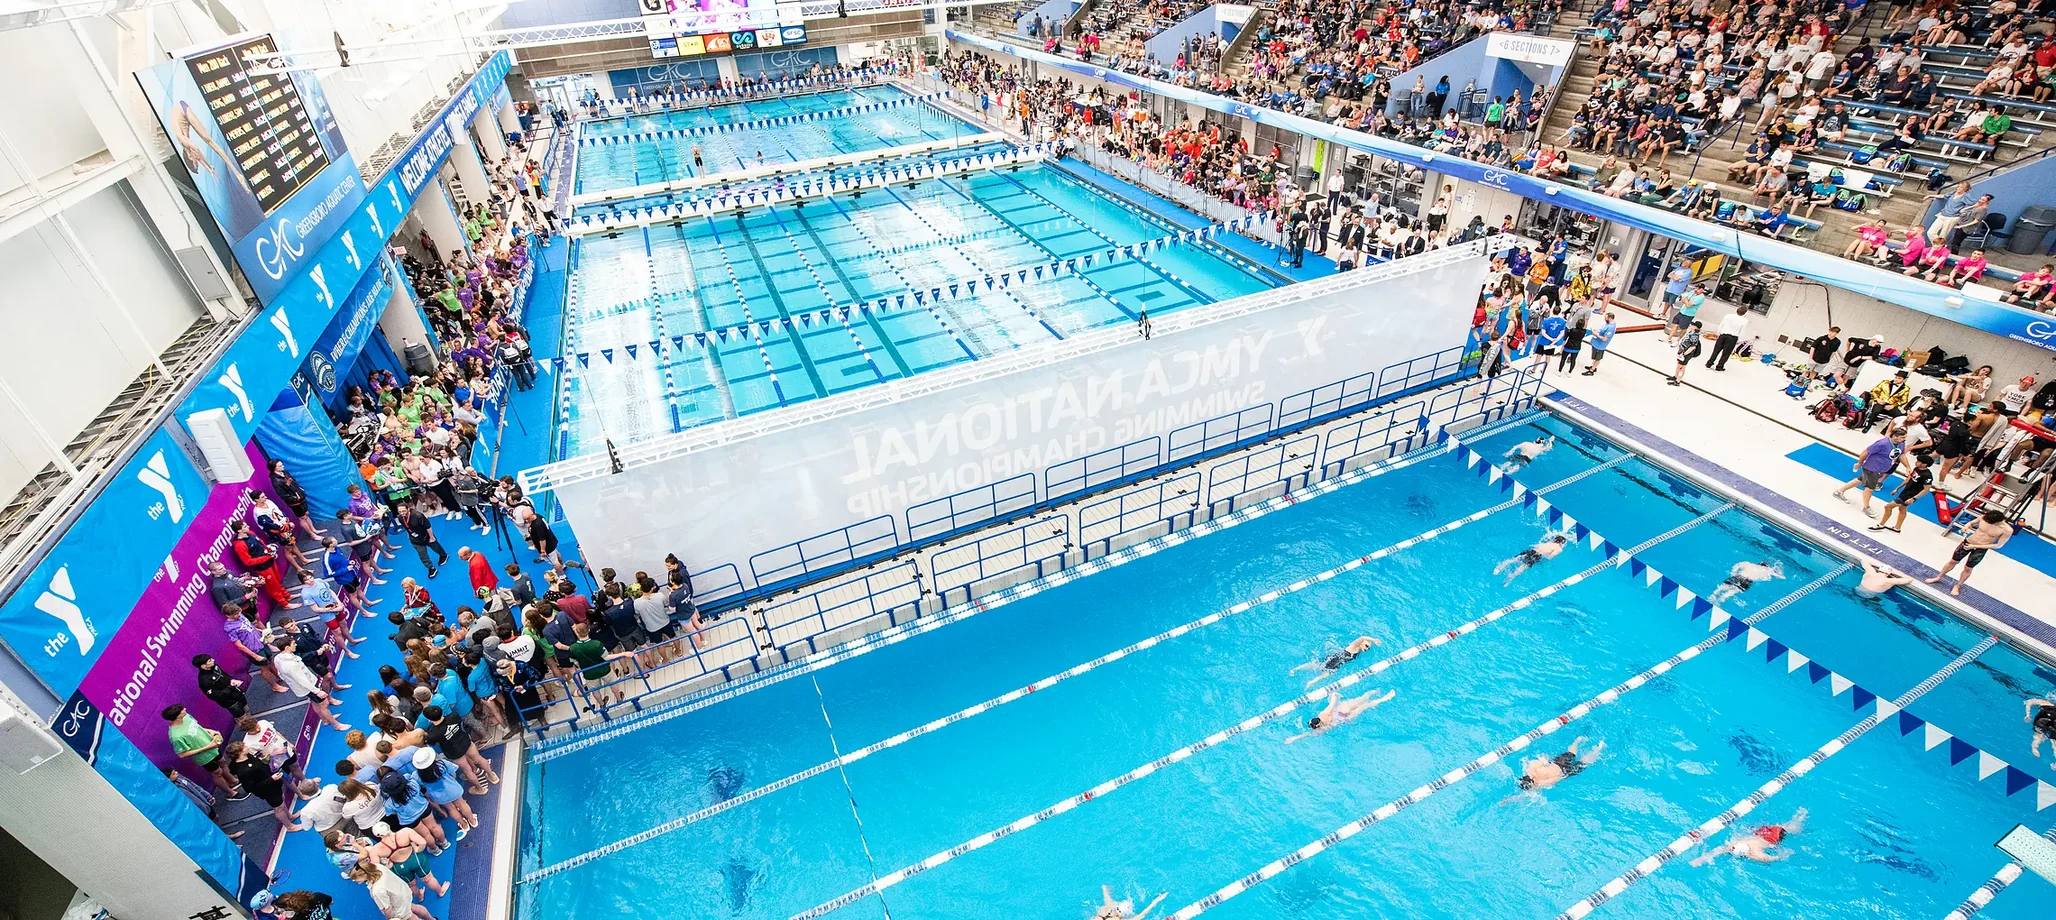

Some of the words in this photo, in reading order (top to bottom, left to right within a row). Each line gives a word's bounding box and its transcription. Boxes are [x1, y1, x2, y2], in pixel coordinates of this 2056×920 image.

[1511, 41, 1548, 55] SECTIONS
[398, 147, 432, 196] WELCOME
[1484, 170, 1508, 185] GAC
[296, 202, 328, 239] GREENSBORO
[325, 186, 345, 212] AQUATIC
[340, 174, 356, 198] CENTER
[256, 218, 304, 280] GAC
[270, 306, 299, 359] Y
[330, 333, 349, 362] WHERE
[344, 303, 368, 342] CHAMPIONS
[2008, 333, 2044, 348] GREENSBORO
[218, 364, 254, 424] Y
[227, 403, 240, 418] the
[2010, 392, 2027, 400] YORK
[137, 450, 184, 524] Y
[148, 500, 165, 521] the
[153, 567, 166, 584] the
[34, 566, 95, 657] Y
[146, 572, 206, 659] Swimming
[43, 631, 70, 658] the
[63, 700, 90, 737] GAC
[303, 724, 311, 742] 6th
